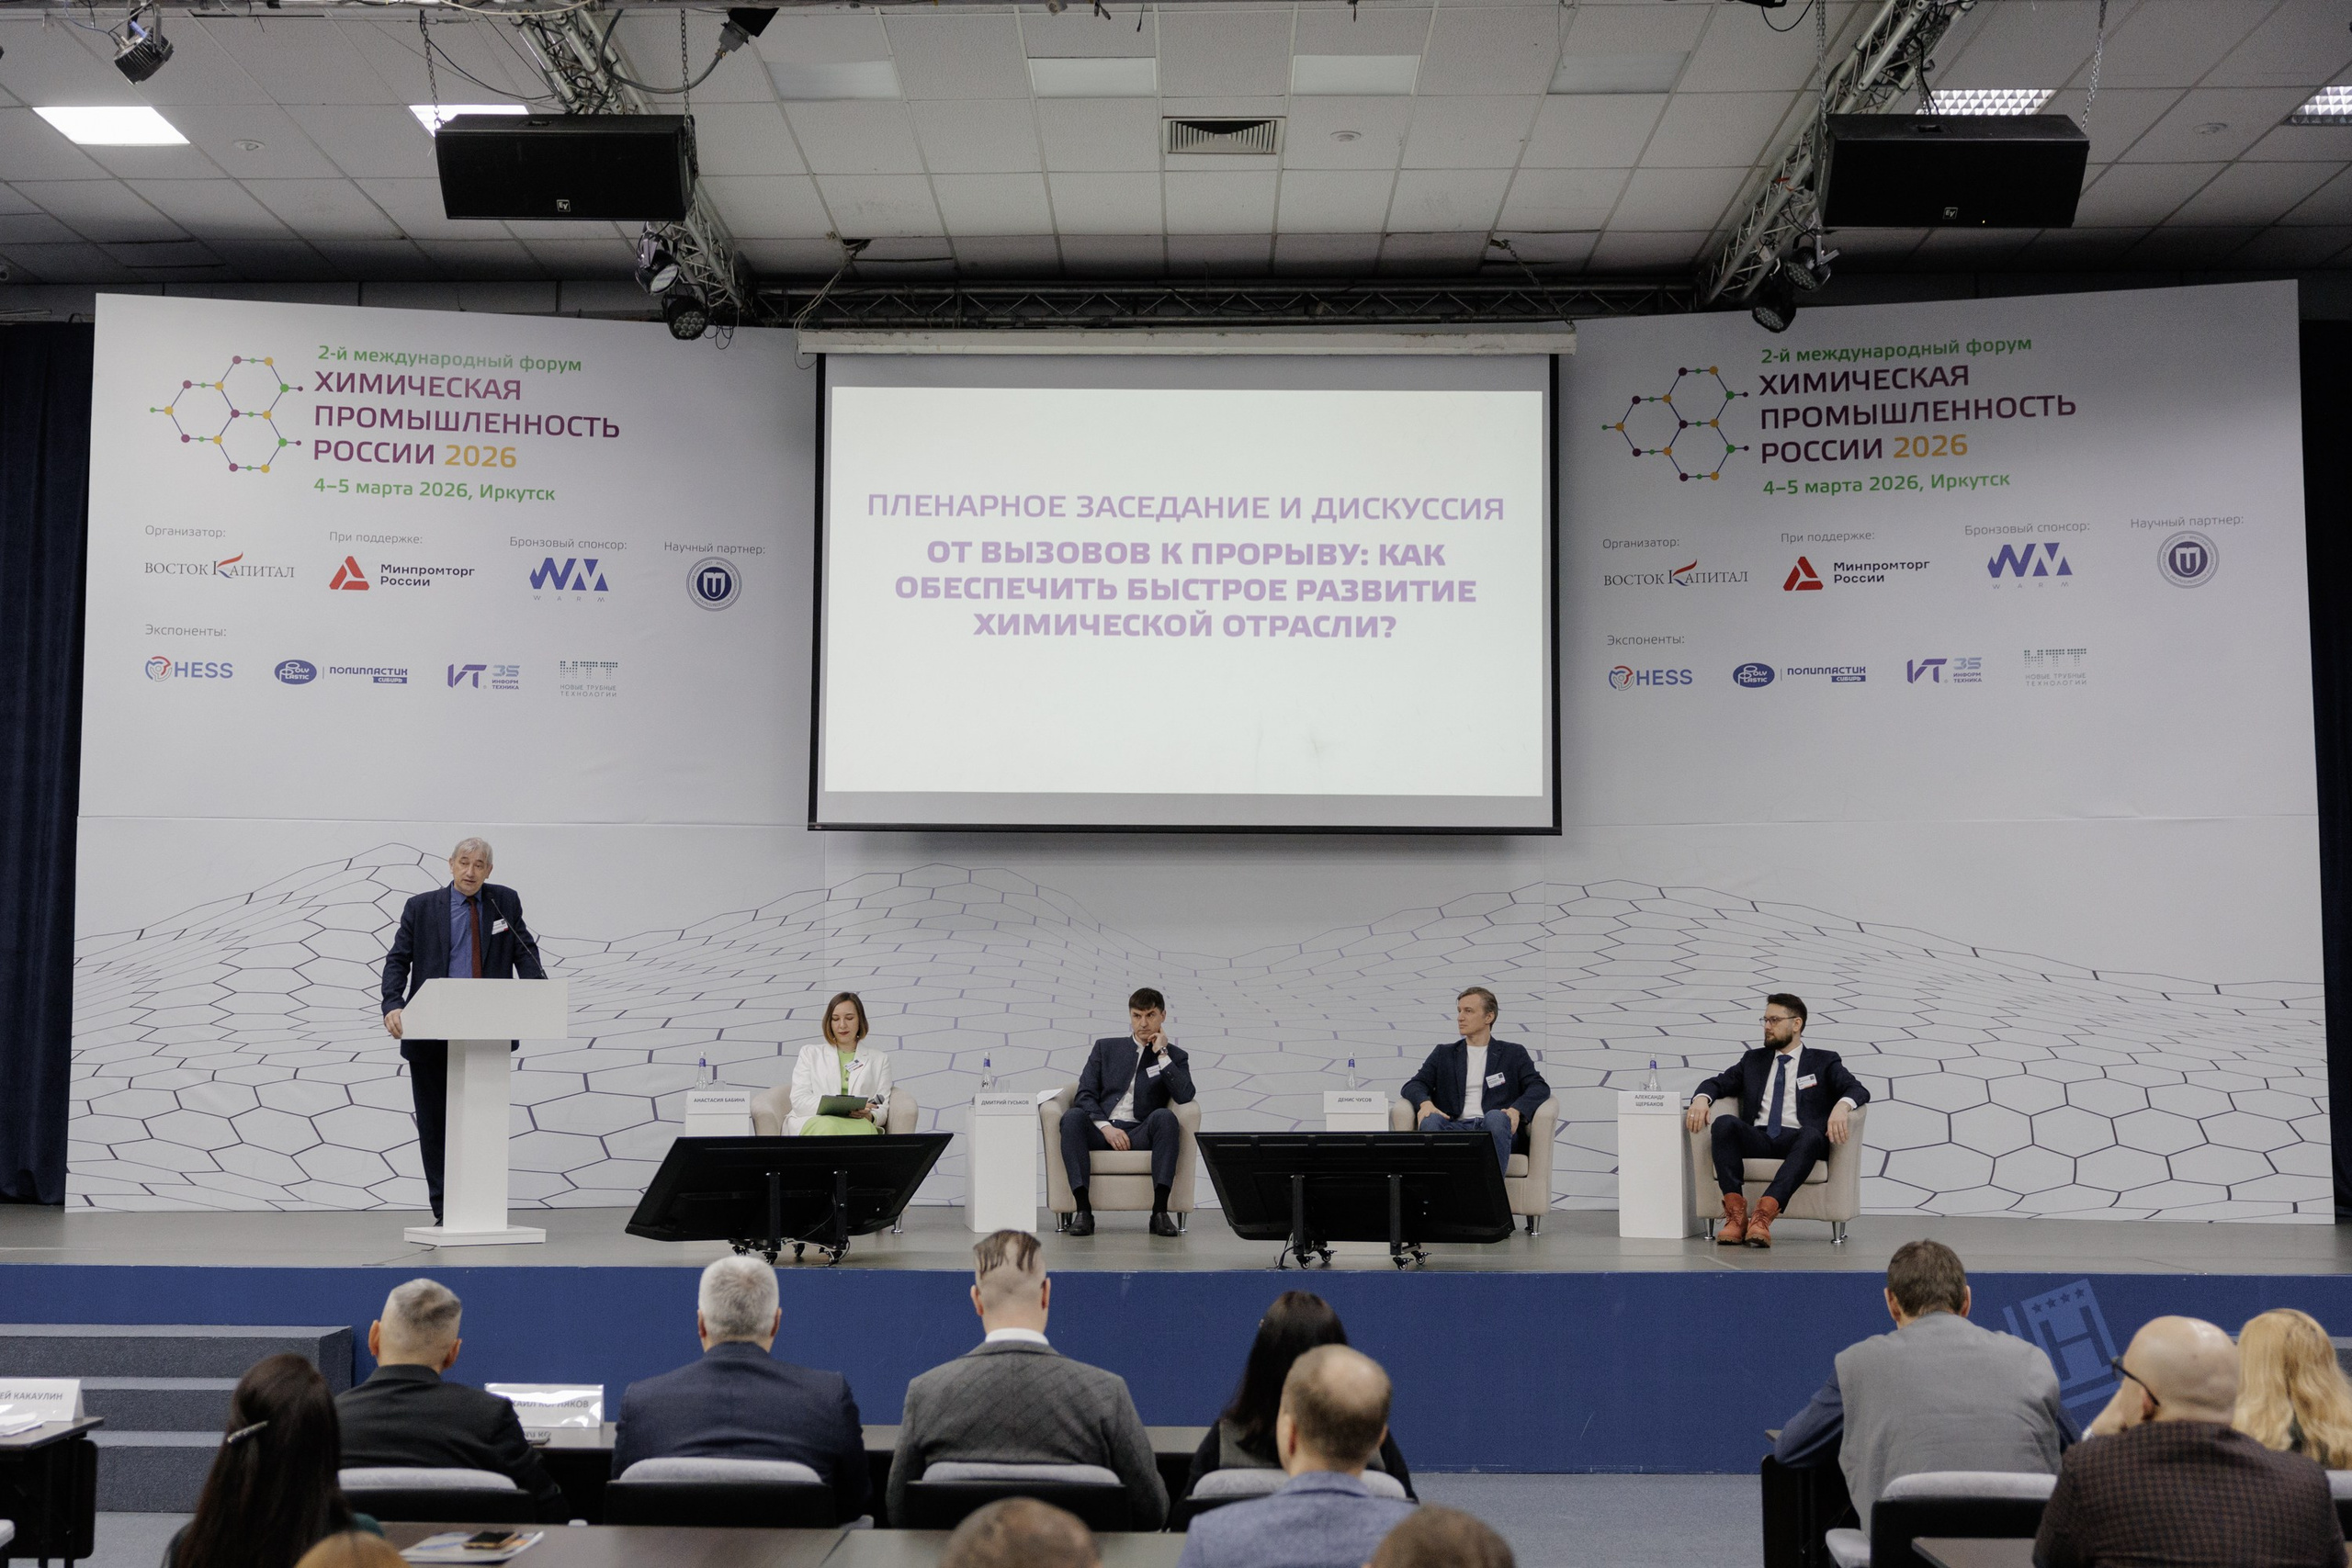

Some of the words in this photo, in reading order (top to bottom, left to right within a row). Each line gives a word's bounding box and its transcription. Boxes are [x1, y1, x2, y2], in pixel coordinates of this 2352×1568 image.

[1761, 348, 1790, 363] 2-й
[1797, 340, 1959, 362] международный
[1966, 338, 2031, 356] форум
[319, 345, 346, 360] 2-й
[354, 348, 513, 368] международный
[520, 355, 581, 374] форум
[315, 371, 520, 400] ХИМИЧЕСКАЯ
[1759, 365, 1968, 395] ХИМИЧЕСКАЯ
[1759, 395, 2075, 429] ПРОМЫШЛЕННОСТЬ
[315, 406, 619, 438] ПРОМЫШЛЕННОСТЬ
[314, 440, 434, 464] РОССИИ
[445, 445, 516, 468] 2026
[1762, 438, 1882, 463] РОССИИ
[1894, 434, 1967, 458] 2026
[314, 479, 349, 492] 4–5
[356, 483, 413, 498] марта
[420, 482, 472, 500] 2026,
[481, 484, 555, 502] Иркутск
[1763, 479, 1798, 494] 4–5
[1804, 480, 1862, 496] марта
[1870, 475, 1923, 491] 2026,
[1931, 474, 2009, 491] Иркутск
[869, 494, 1066, 517] ПЛЕНАРНОЕ
[1077, 495, 1269, 523] ЗАСЕДАНИЕ
[1281, 497, 1301, 519] И
[1312, 498, 1503, 524] ДИСКУССИЯ
[1965, 524, 2033, 537] Бронзовый
[2037, 521, 2089, 533] спонсор:
[2131, 517, 2185, 529] Научный
[2189, 516, 2244, 527] партнер:
[145, 525, 225, 539] Организатор:
[330, 532, 352, 543] При
[356, 535, 423, 545] поддержке:
[1781, 533, 1803, 544] При
[1808, 533, 1874, 542] поддержке:
[510, 536, 574, 547] Бронзовый
[579, 541, 627, 551] спонсор:
[665, 542, 713, 553] Научный
[717, 544, 765, 556] партнер:
[1603, 539, 1679, 550] Организатор:
[928, 541, 972, 563] ОТ
[982, 542, 1150, 564] ВЫЗОВОВ
[1162, 543, 1182, 564] К
[1193, 543, 1368, 566] ПРОРЫВУ:
[1380, 544, 1445, 566] КАК
[145, 563, 208, 575] ВОСТОК
[212, 551, 294, 579] КАПИТАЛ
[380, 563, 476, 576] Минпромторг
[1604, 574, 1664, 586] ВОСТОК
[1668, 559, 1747, 586] КАПИТАЛ
[1834, 561, 1929, 574] Минпромторг
[380, 576, 431, 586] России
[1834, 573, 1884, 584] России
[896, 576, 1117, 600] ОБЕСПЕЧИТЬ
[1128, 579, 1286, 601] БЫСТРОЕ
[1297, 580, 1476, 602] РАЗВИТИЕ
[145, 624, 226, 637] Экспоненты:
[974, 610, 1212, 637] ХИМИЧЕСКОЙ
[1223, 615, 1396, 637] ОТРАСЛИ?
[1607, 635, 1684, 645] Экспоненты:
[174, 661, 232, 678] HESS
[329, 666, 408, 676] ПОЛИПЛАСТИК
[1636, 670, 1692, 685] HESS
[1787, 666, 1867, 676] ПОЛИПЛАСТИК
[13, 1392, 63, 1401] КАКАУЛИН
